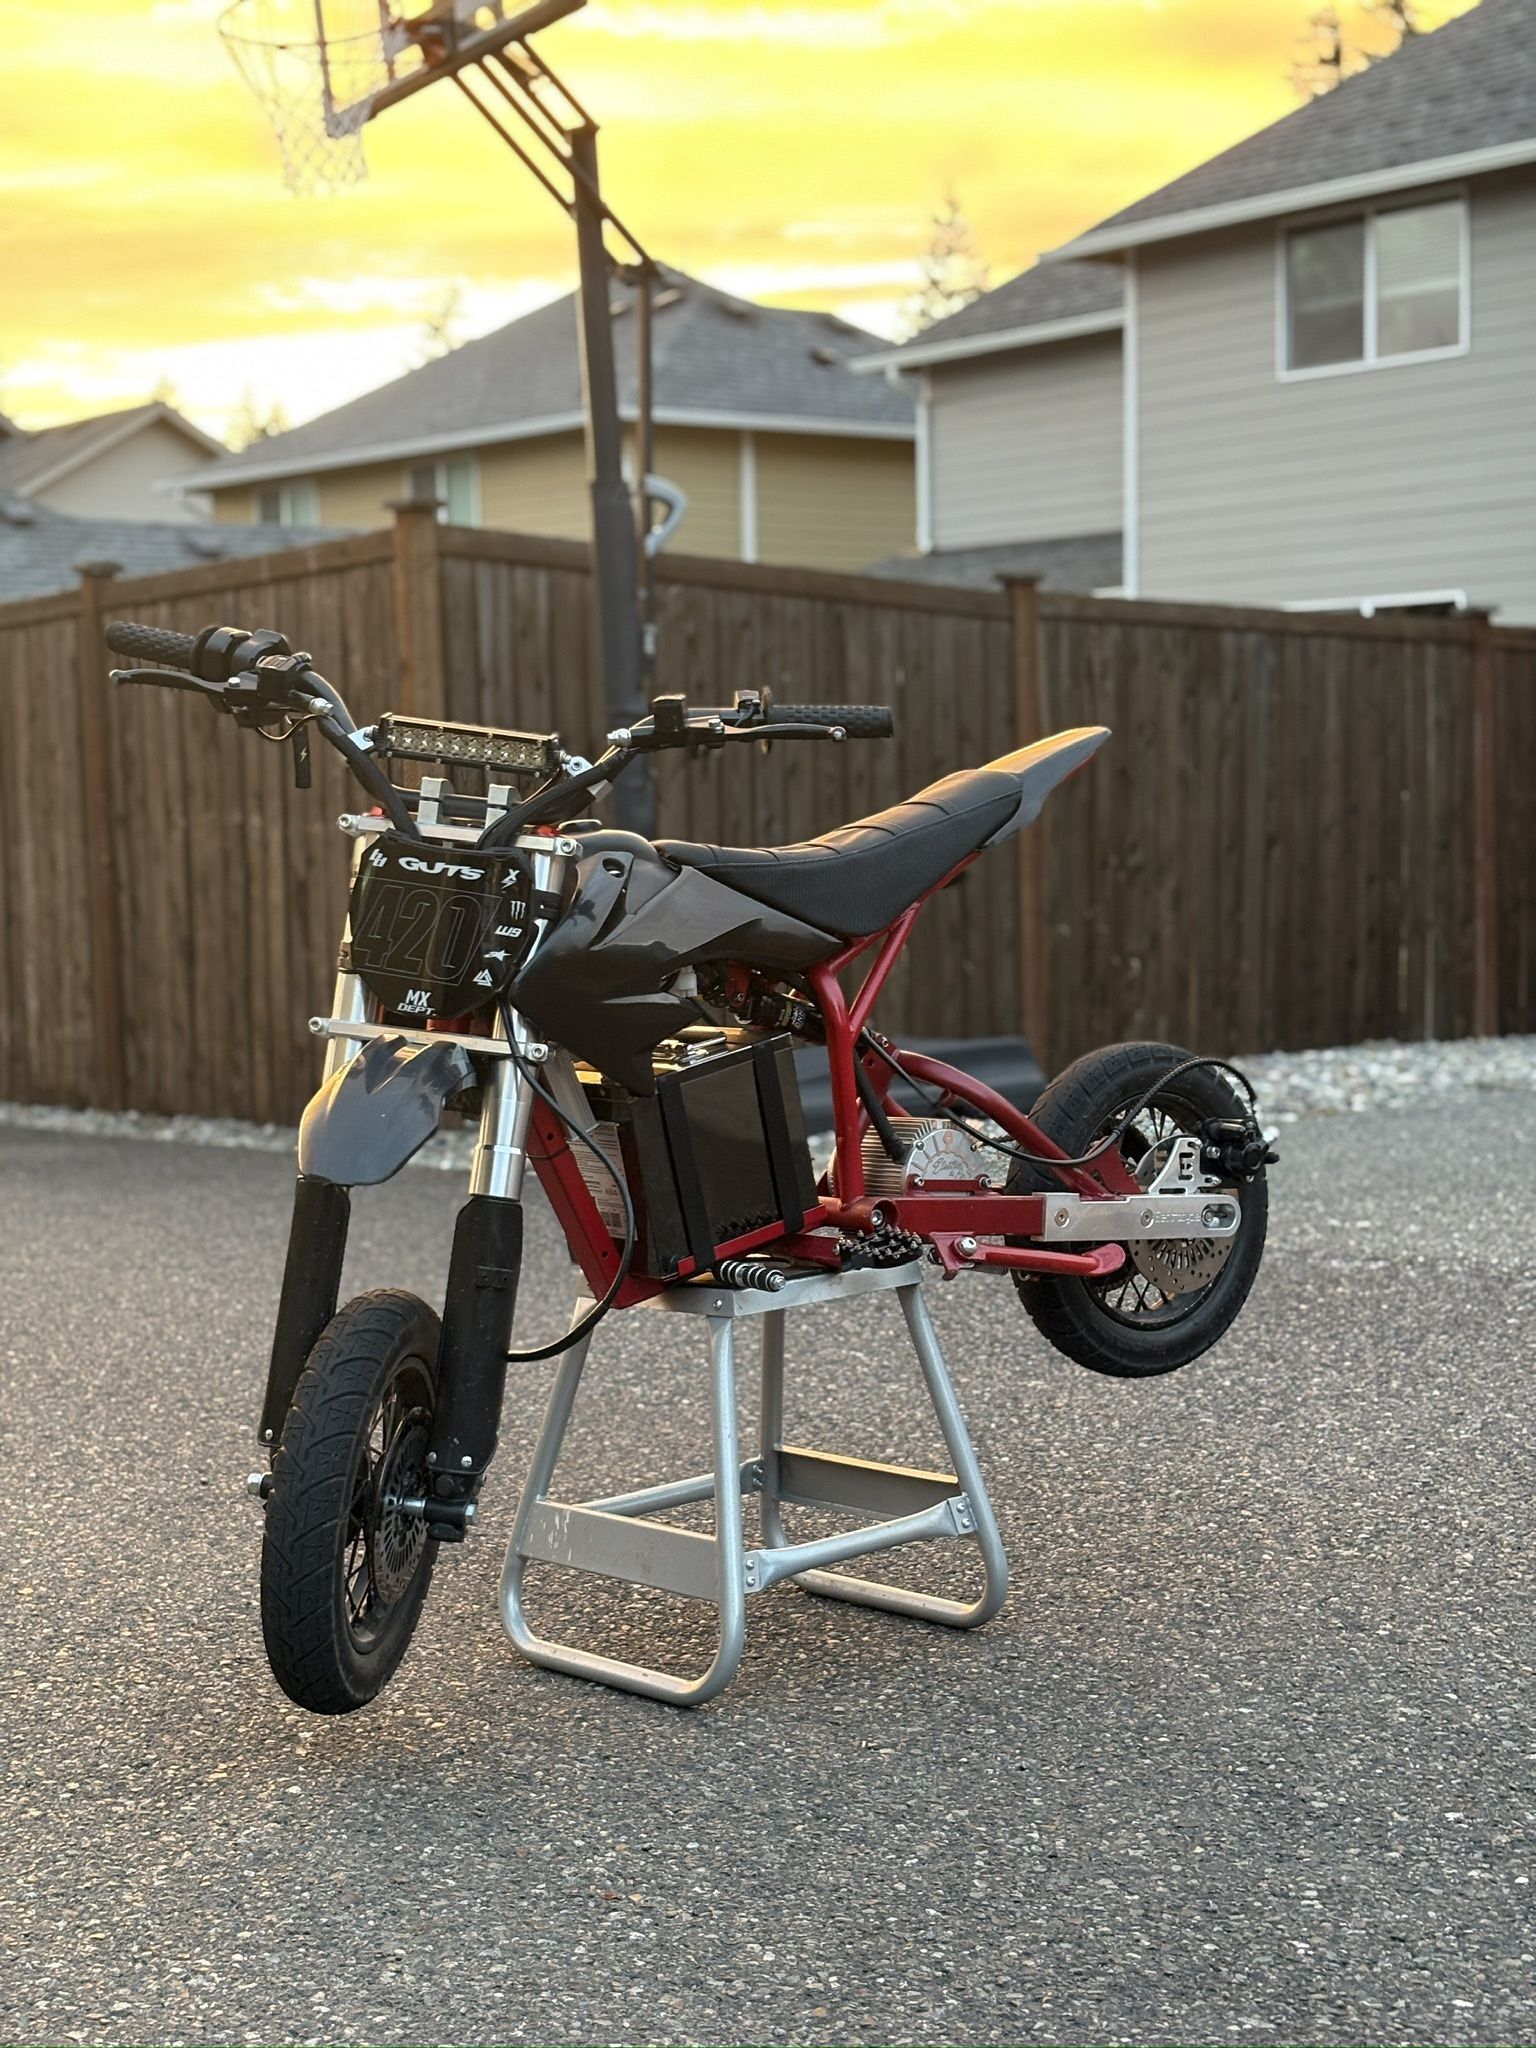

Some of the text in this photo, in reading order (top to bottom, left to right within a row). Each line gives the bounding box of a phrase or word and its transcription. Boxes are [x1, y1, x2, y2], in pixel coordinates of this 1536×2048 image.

[398, 857, 486, 881] GUTS
[354, 884, 482, 981] 420
[405, 989, 432, 1008] MX
[397, 1003, 437, 1017] DEPT.
